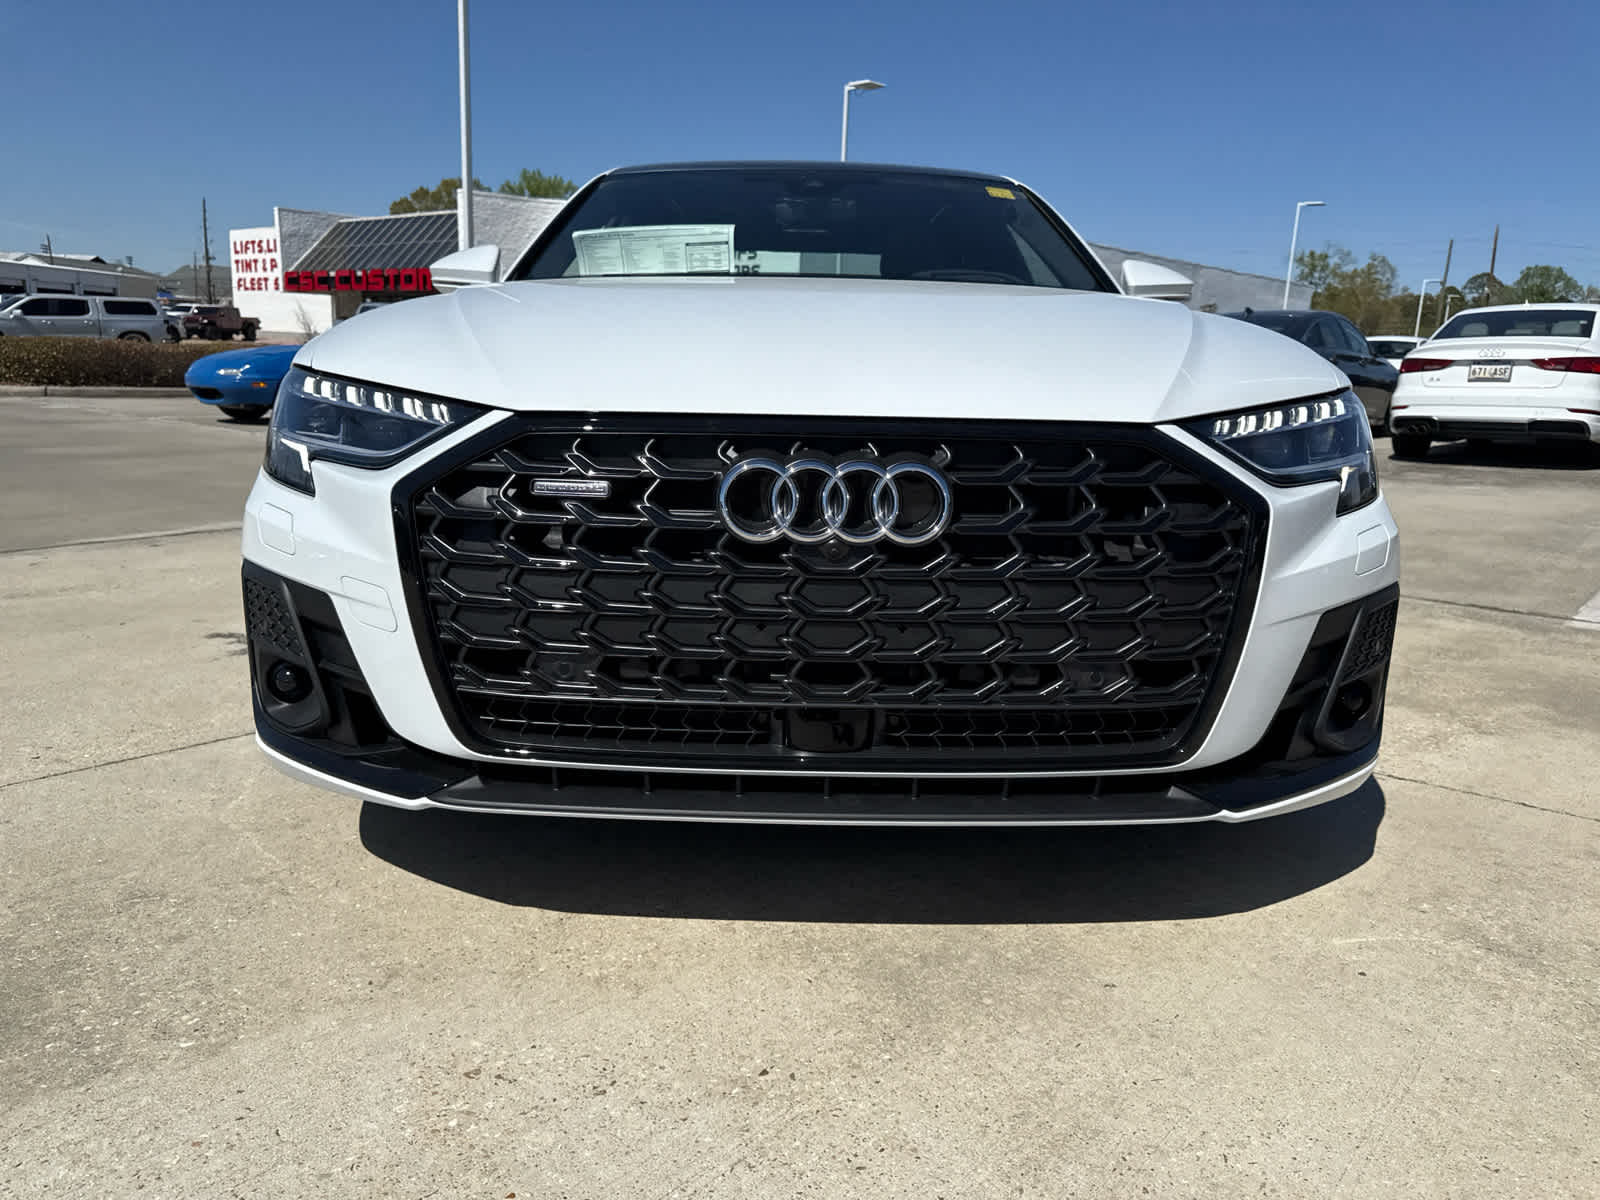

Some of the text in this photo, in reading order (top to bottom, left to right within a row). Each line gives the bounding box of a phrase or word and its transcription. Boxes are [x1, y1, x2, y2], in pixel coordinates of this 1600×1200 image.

[234, 258, 258, 273] TINT
[237, 277, 269, 291] FLEET
[284, 270, 329, 292] CSC
[1472, 367, 1487, 377] 671
